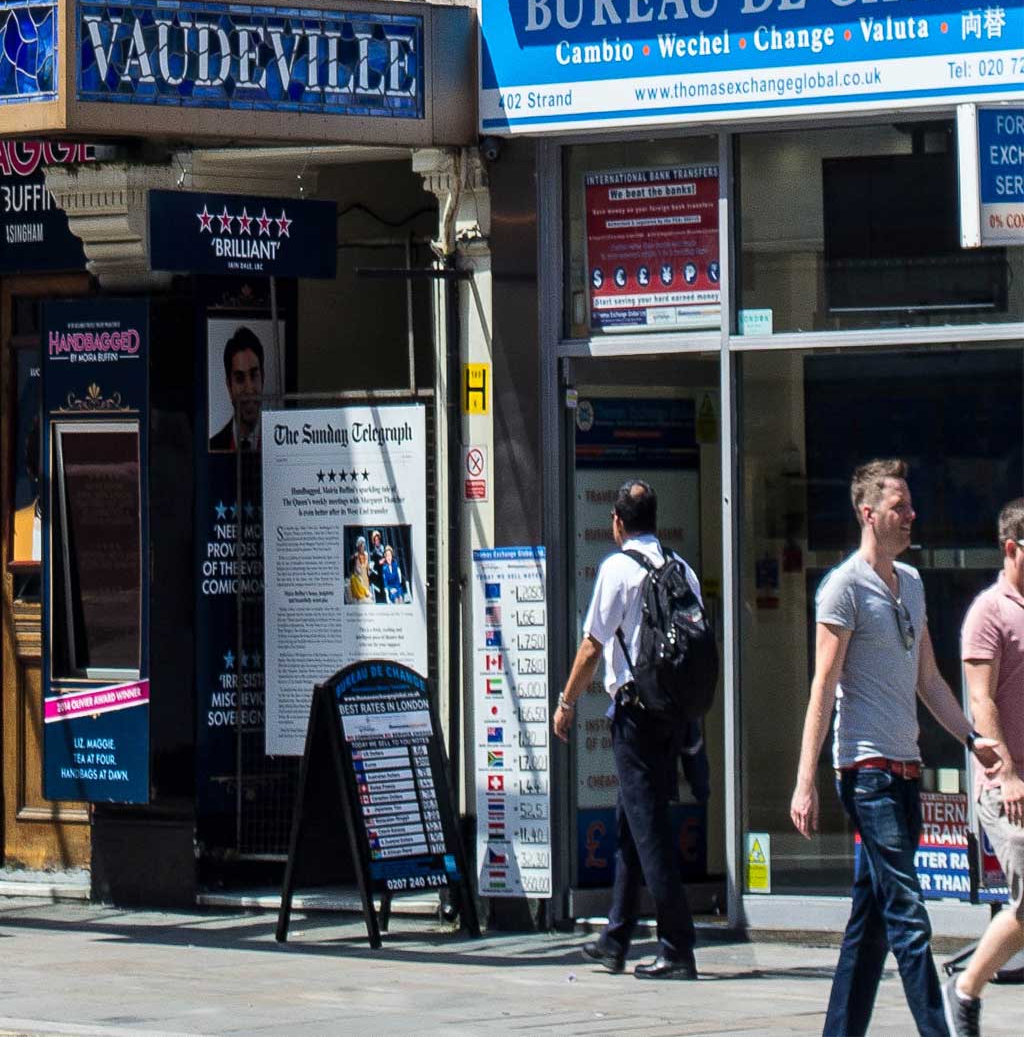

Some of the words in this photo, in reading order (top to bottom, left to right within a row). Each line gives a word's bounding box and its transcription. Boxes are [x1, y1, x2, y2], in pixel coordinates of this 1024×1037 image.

[555, 37, 635, 66] Cambio
[657, 28, 731, 59] Wechel
[752, 24, 835, 54] Change
[858, 16, 929, 43] Valuta
[82, 14, 417, 98] VAUDEVILLE
[497, 92, 522, 112] 402
[527, 89, 573, 111] Strand
[633, 65, 883, 107] www.thomasexchangeglobal.co.uk
[946, 60, 972, 80] Tel:
[978, 56, 1005, 78] 020
[585, 172, 648, 186] INTERNATIONAL
[649, 169, 671, 183] BANK
[673, 165, 718, 180] TRANSFERS
[610, 190, 623, 200] We
[625, 188, 645, 199] beat
[647, 186, 663, 198] the
[665, 183, 696, 196] banks!
[594, 297, 612, 307] Start
[637, 295, 653, 306] your
[653, 293, 669, 304] hard
[670, 293, 695, 303] earned
[696, 292, 720, 303] money
[47, 328, 141, 355] HANDBAGGED
[273, 422, 300, 447] The
[300, 422, 350, 449] Sunday
[351, 421, 413, 446] Telegraph
[202, 561, 219, 577] OF
[219, 560, 239, 577] THE
[201, 578, 240, 595] COMIC
[71, 694, 94, 711] OLIVIER
[93, 691, 116, 706] AWARD
[116, 685, 143, 702] WINNER
[338, 702, 359, 715] BEST
[359, 701, 387, 714] RATES
[386, 700, 396, 712] IN
[396, 698, 430, 712] LONDON
[73, 753, 87, 765] TEA
[86, 753, 95, 765] AT
[60, 767, 98, 781] HANDBAGS
[98, 768, 108, 781] AT
[386, 877, 407, 891] 0207
[409, 876, 426, 889] 240
[426, 873, 448, 887] 1214
